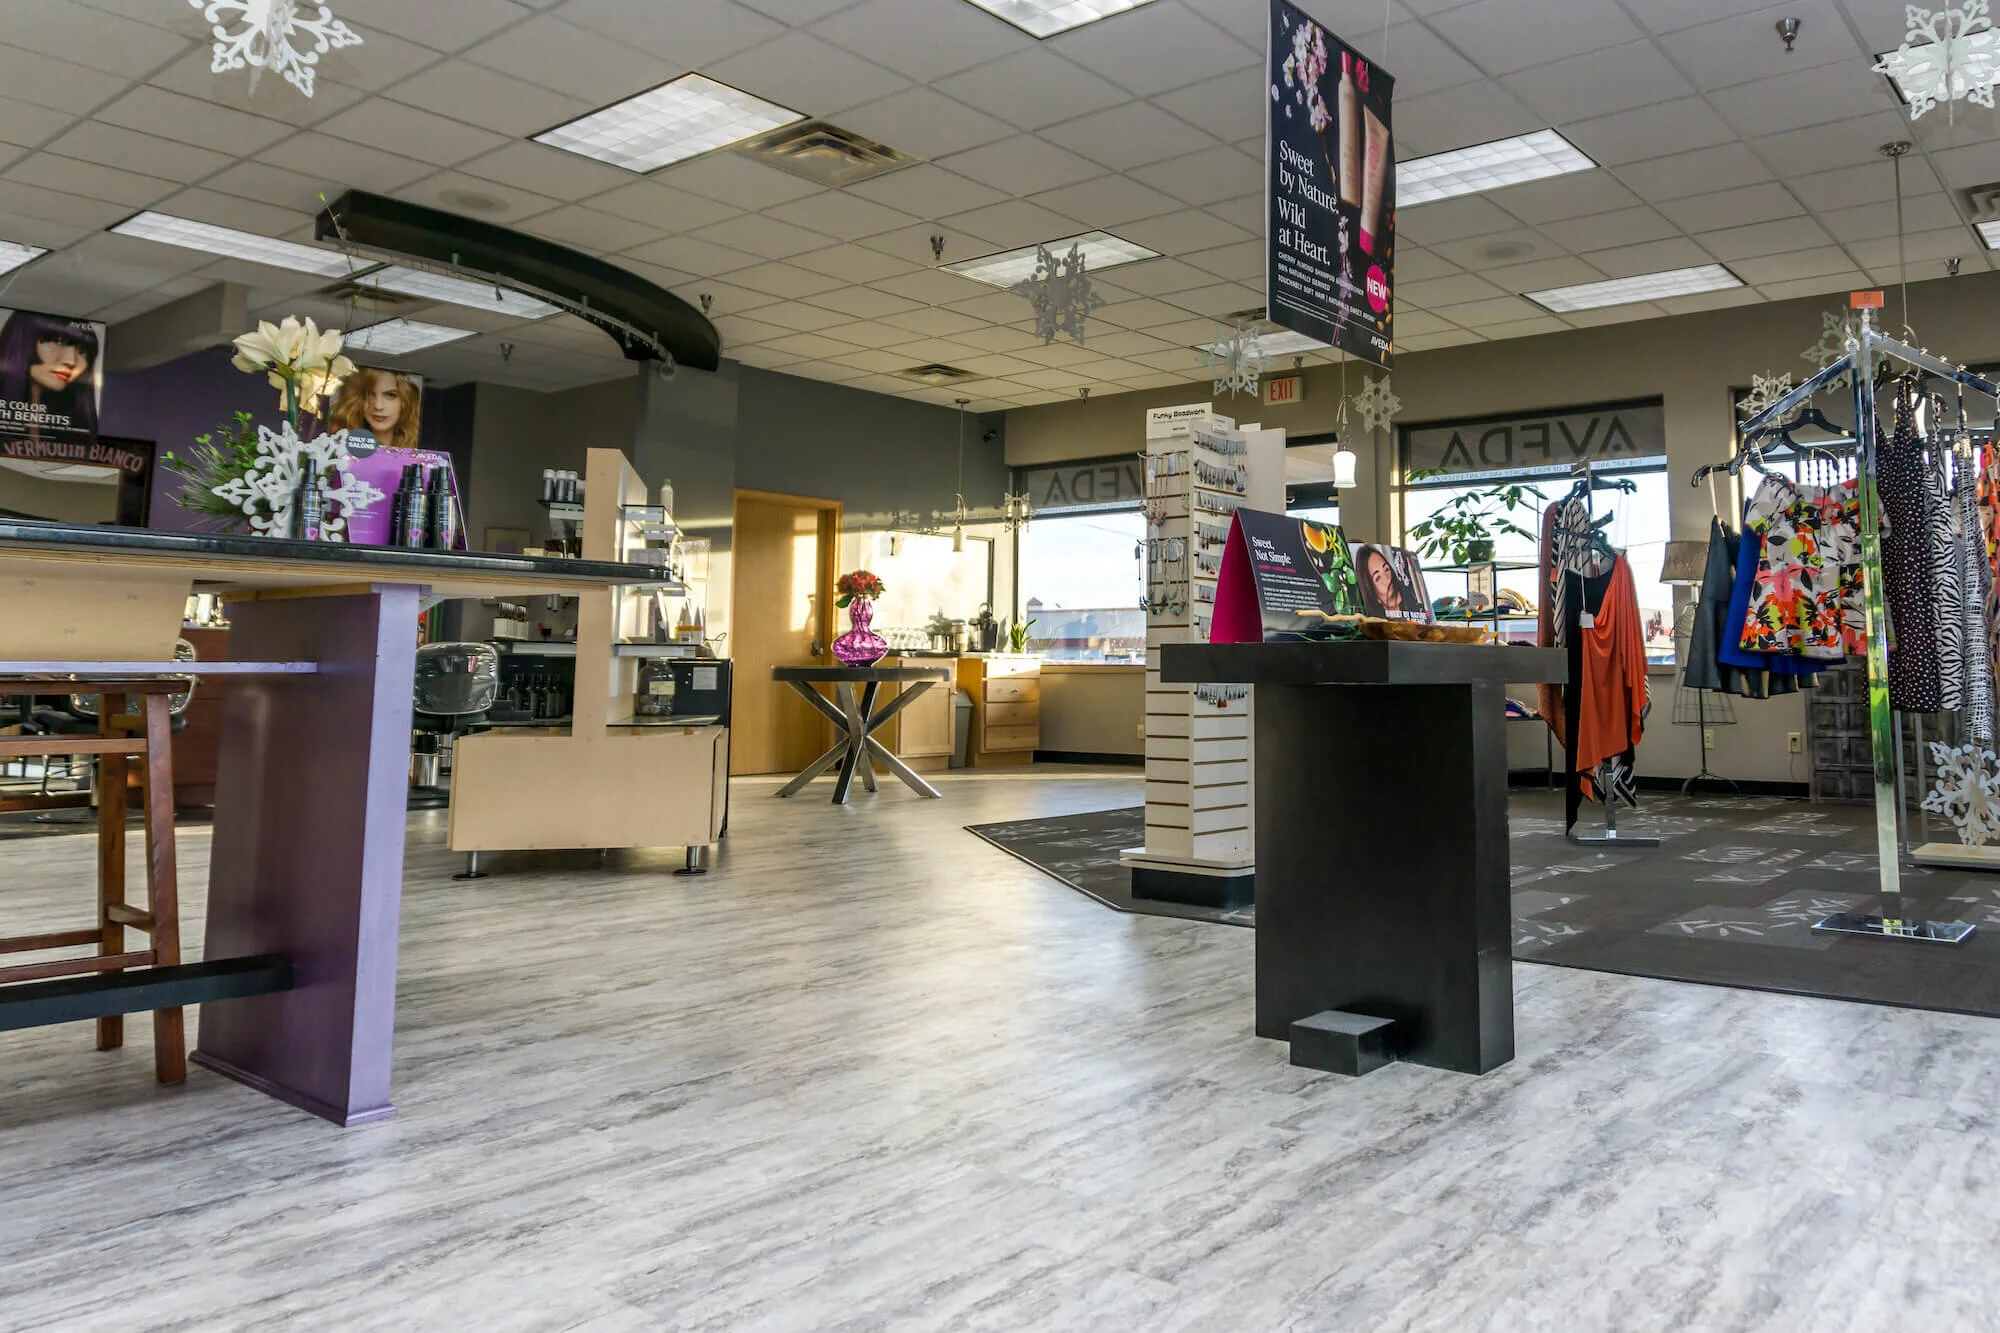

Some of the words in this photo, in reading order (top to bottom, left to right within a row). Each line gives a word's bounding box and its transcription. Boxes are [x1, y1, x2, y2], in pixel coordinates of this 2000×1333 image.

[1279, 139, 1314, 177] Sweet
[1279, 162, 1295, 194] by
[1298, 174, 1339, 214] Nature.
[1277, 196, 1306, 229] Wild
[1278, 227, 1291, 247] at
[1367, 277, 1387, 300] NEW
[1370, 336, 1389, 352] AVEDA
[1270, 378, 1294, 401] EXIT
[9, 401, 47, 413] COLOR
[1153, 411, 1172, 420] Funky
[1173, 408, 1206, 418] Beadwork
[15, 411, 71, 426] BENEFITS
[348, 435, 365, 443] ONLY
[348, 441, 375, 450] SALONS
[89, 444, 143, 472] BIANCO
[416, 453, 442, 461] AVEDA
[1255, 549, 1269, 561] Not
